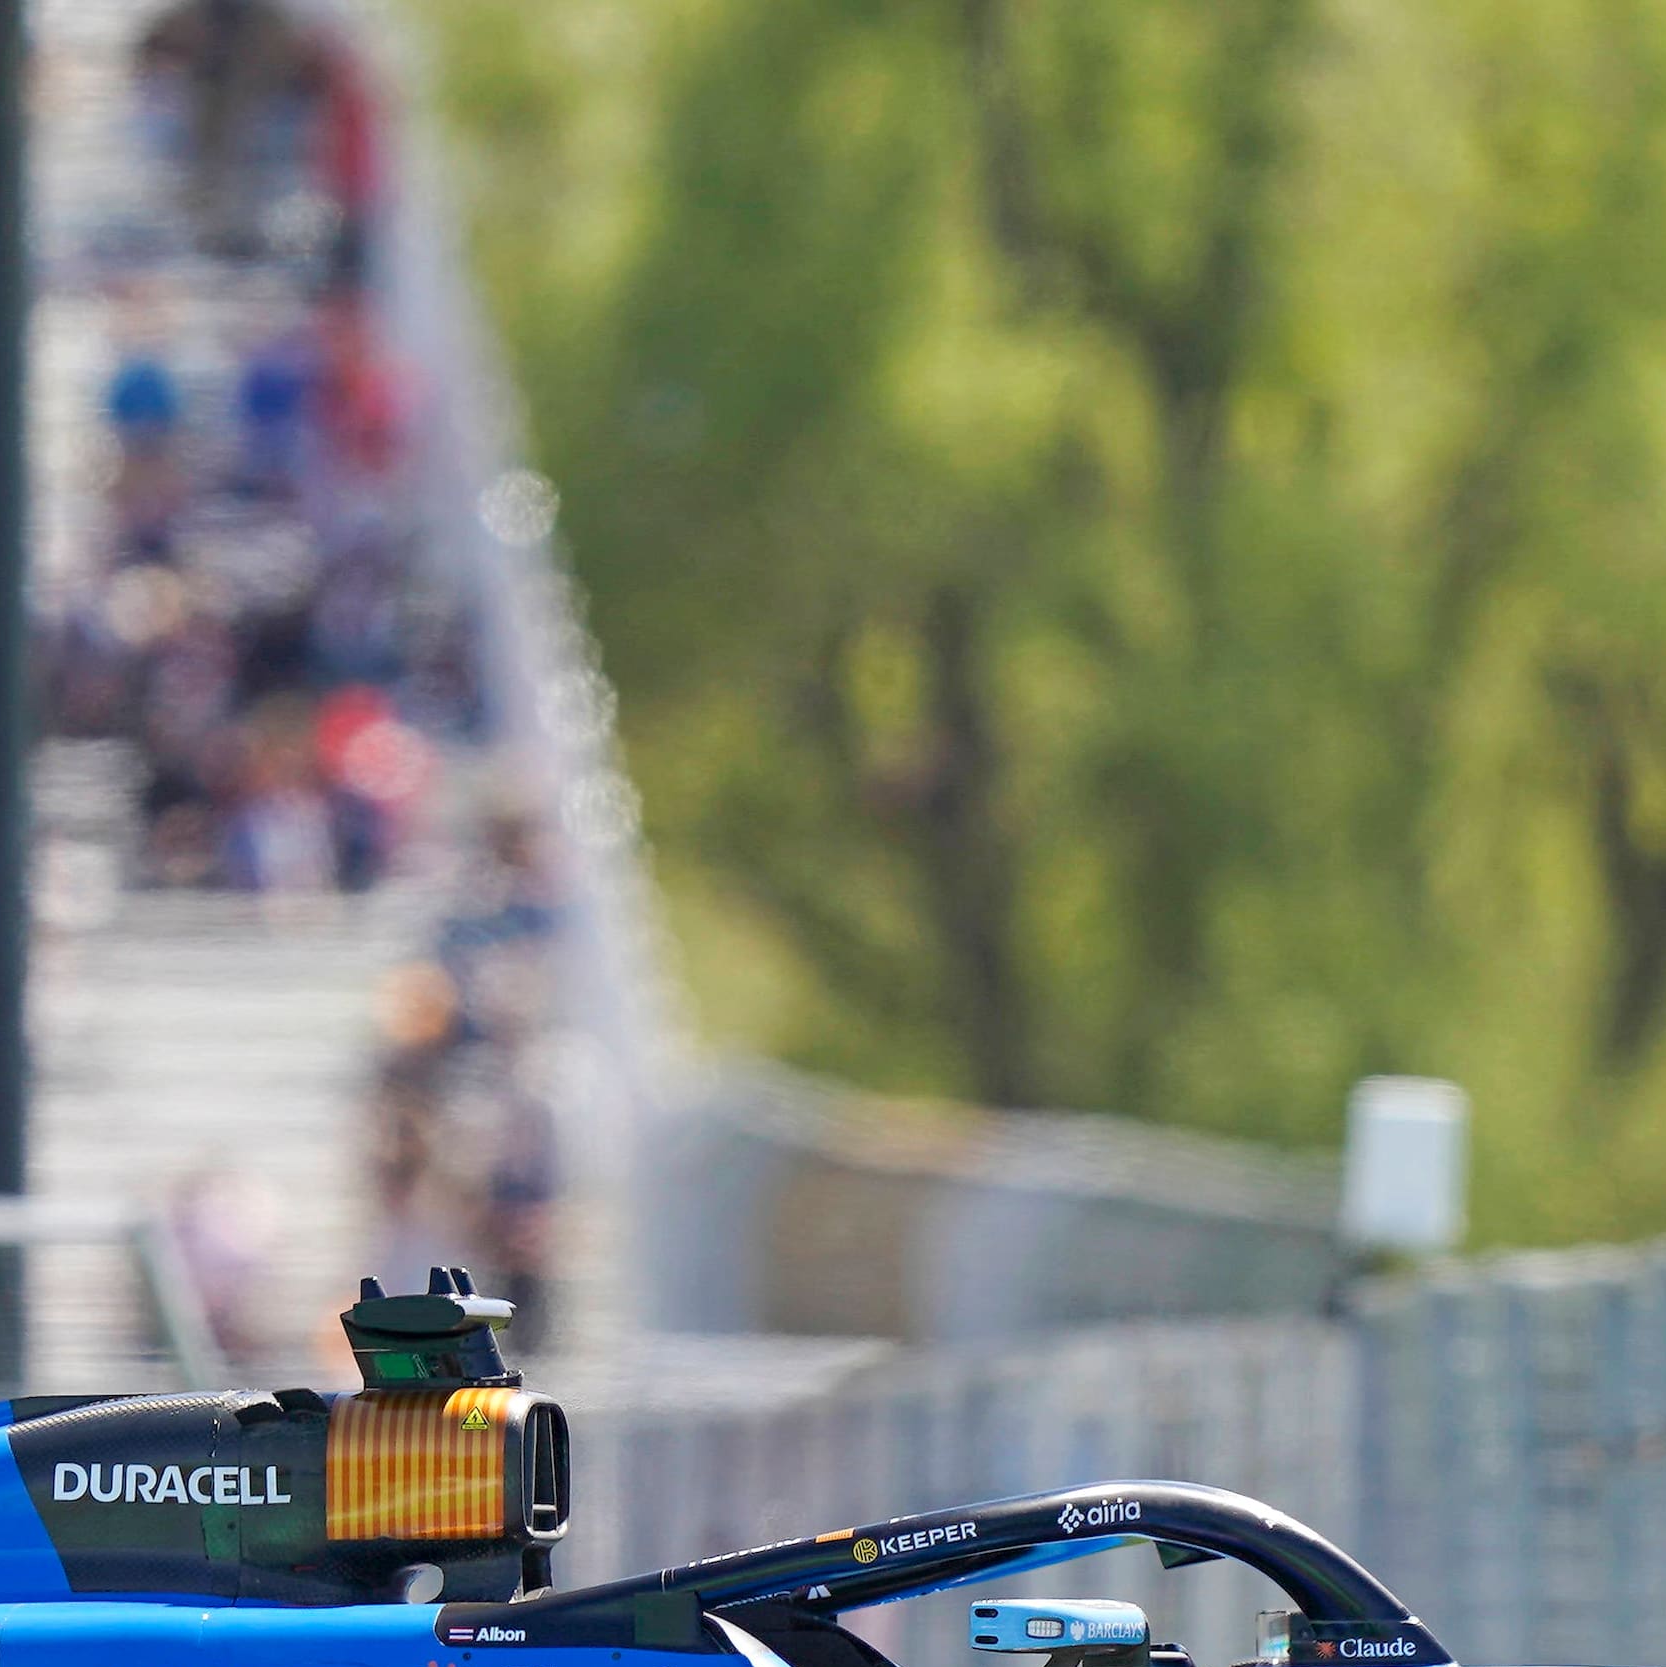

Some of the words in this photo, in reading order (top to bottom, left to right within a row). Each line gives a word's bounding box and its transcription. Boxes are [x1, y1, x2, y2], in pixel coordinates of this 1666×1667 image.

[53, 1463, 291, 1506] DURACELL
[1087, 1497, 1141, 1526] airia
[881, 1521, 978, 1556] KEEPER
[475, 1627, 526, 1643] Albon
[1088, 1622, 1146, 1639] BARCLAYS
[1339, 1637, 1417, 1659] Claude
